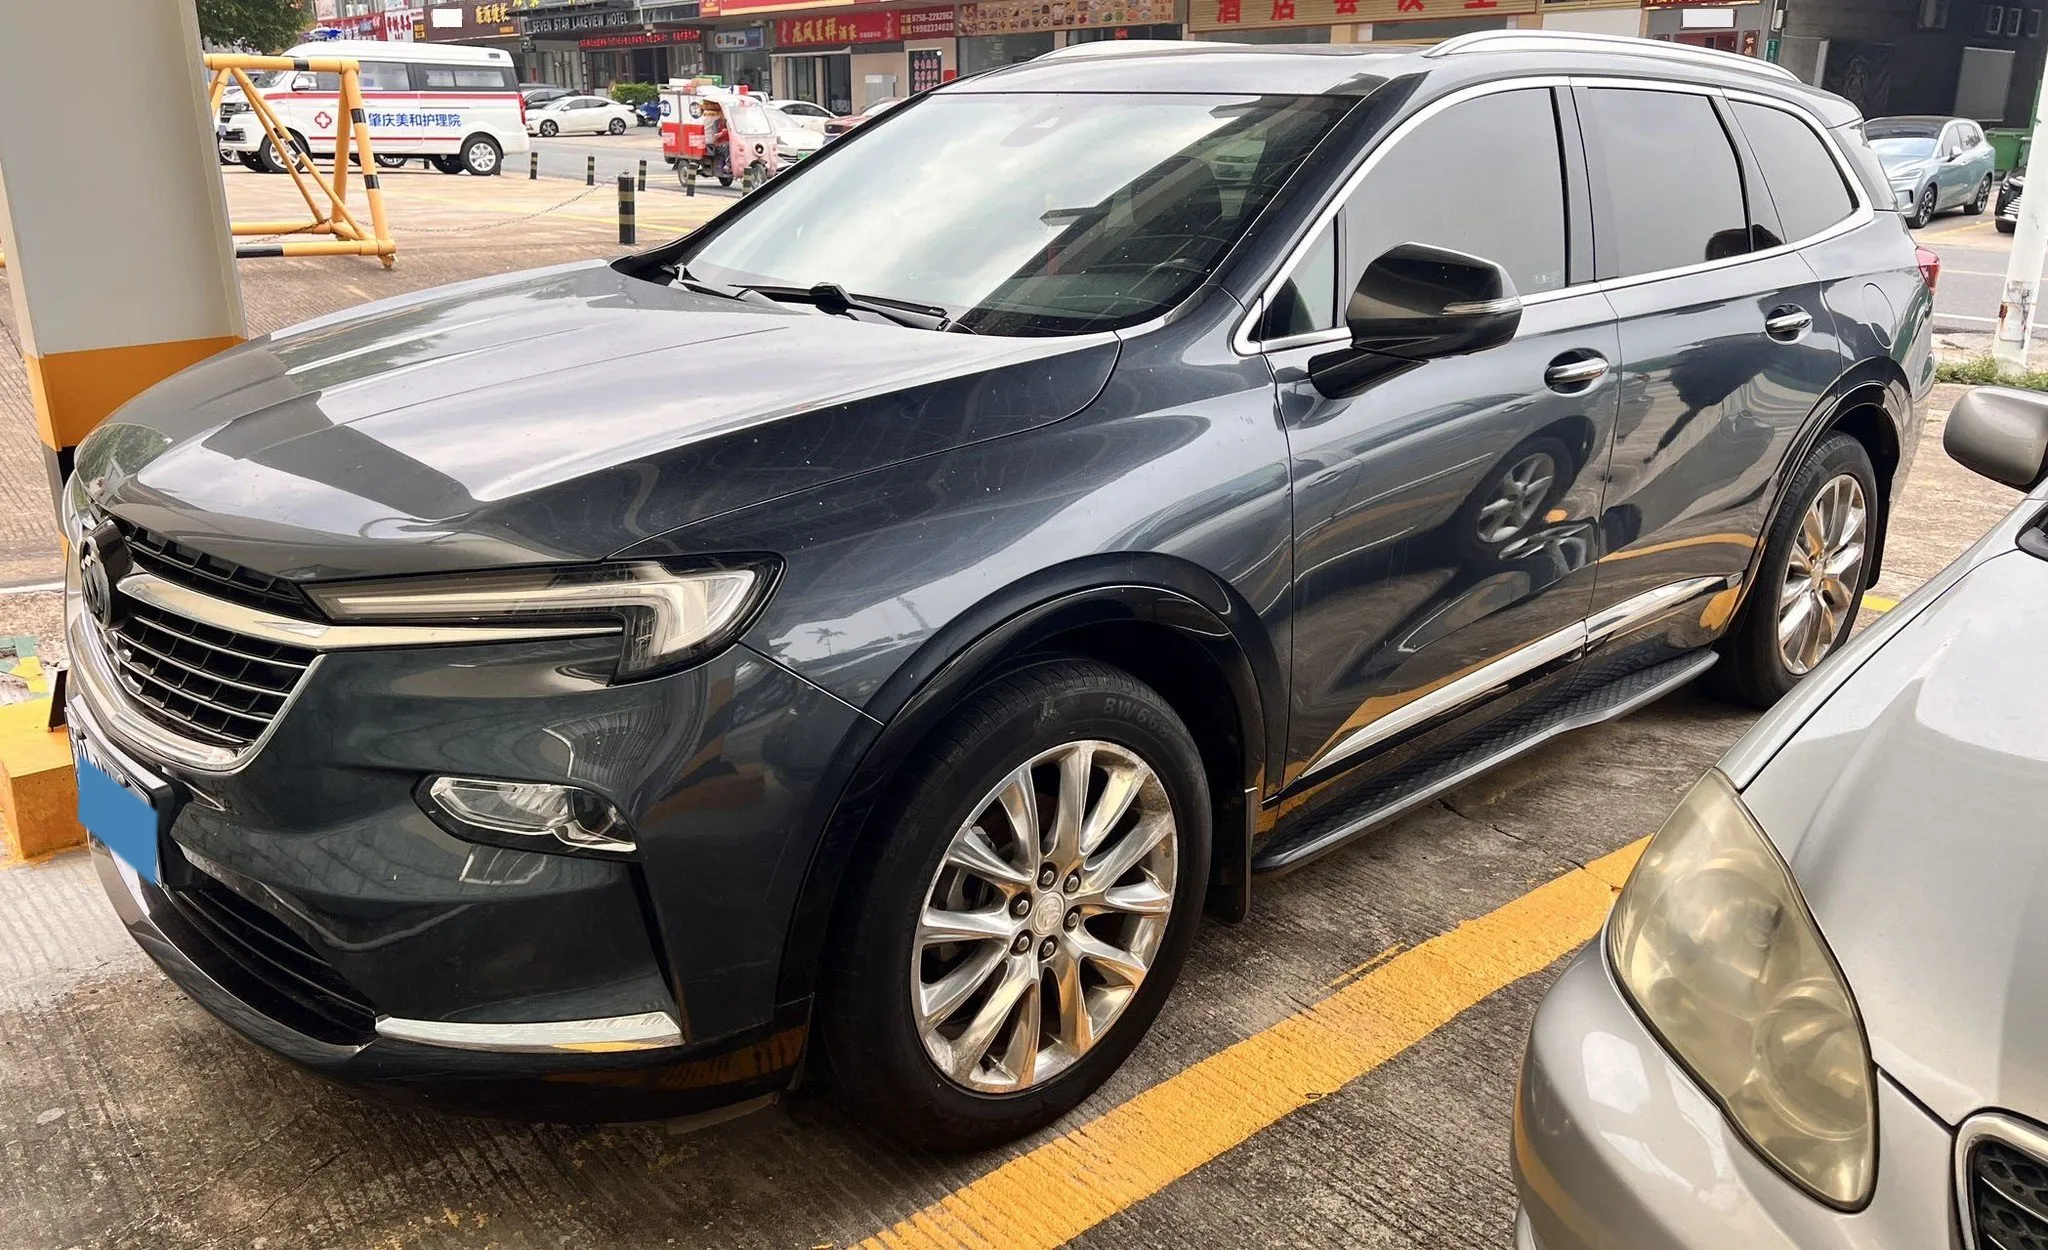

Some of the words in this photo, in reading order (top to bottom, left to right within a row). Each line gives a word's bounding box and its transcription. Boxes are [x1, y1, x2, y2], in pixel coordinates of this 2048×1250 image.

[532, 18, 552, 33] SEVEN
[553, 17, 570, 31] STAR
[572, 14, 604, 30] LAKEVIEW
[606, 12, 629, 26] HOTEL
[368, 112, 462, 127] 肇庆美和护理院
